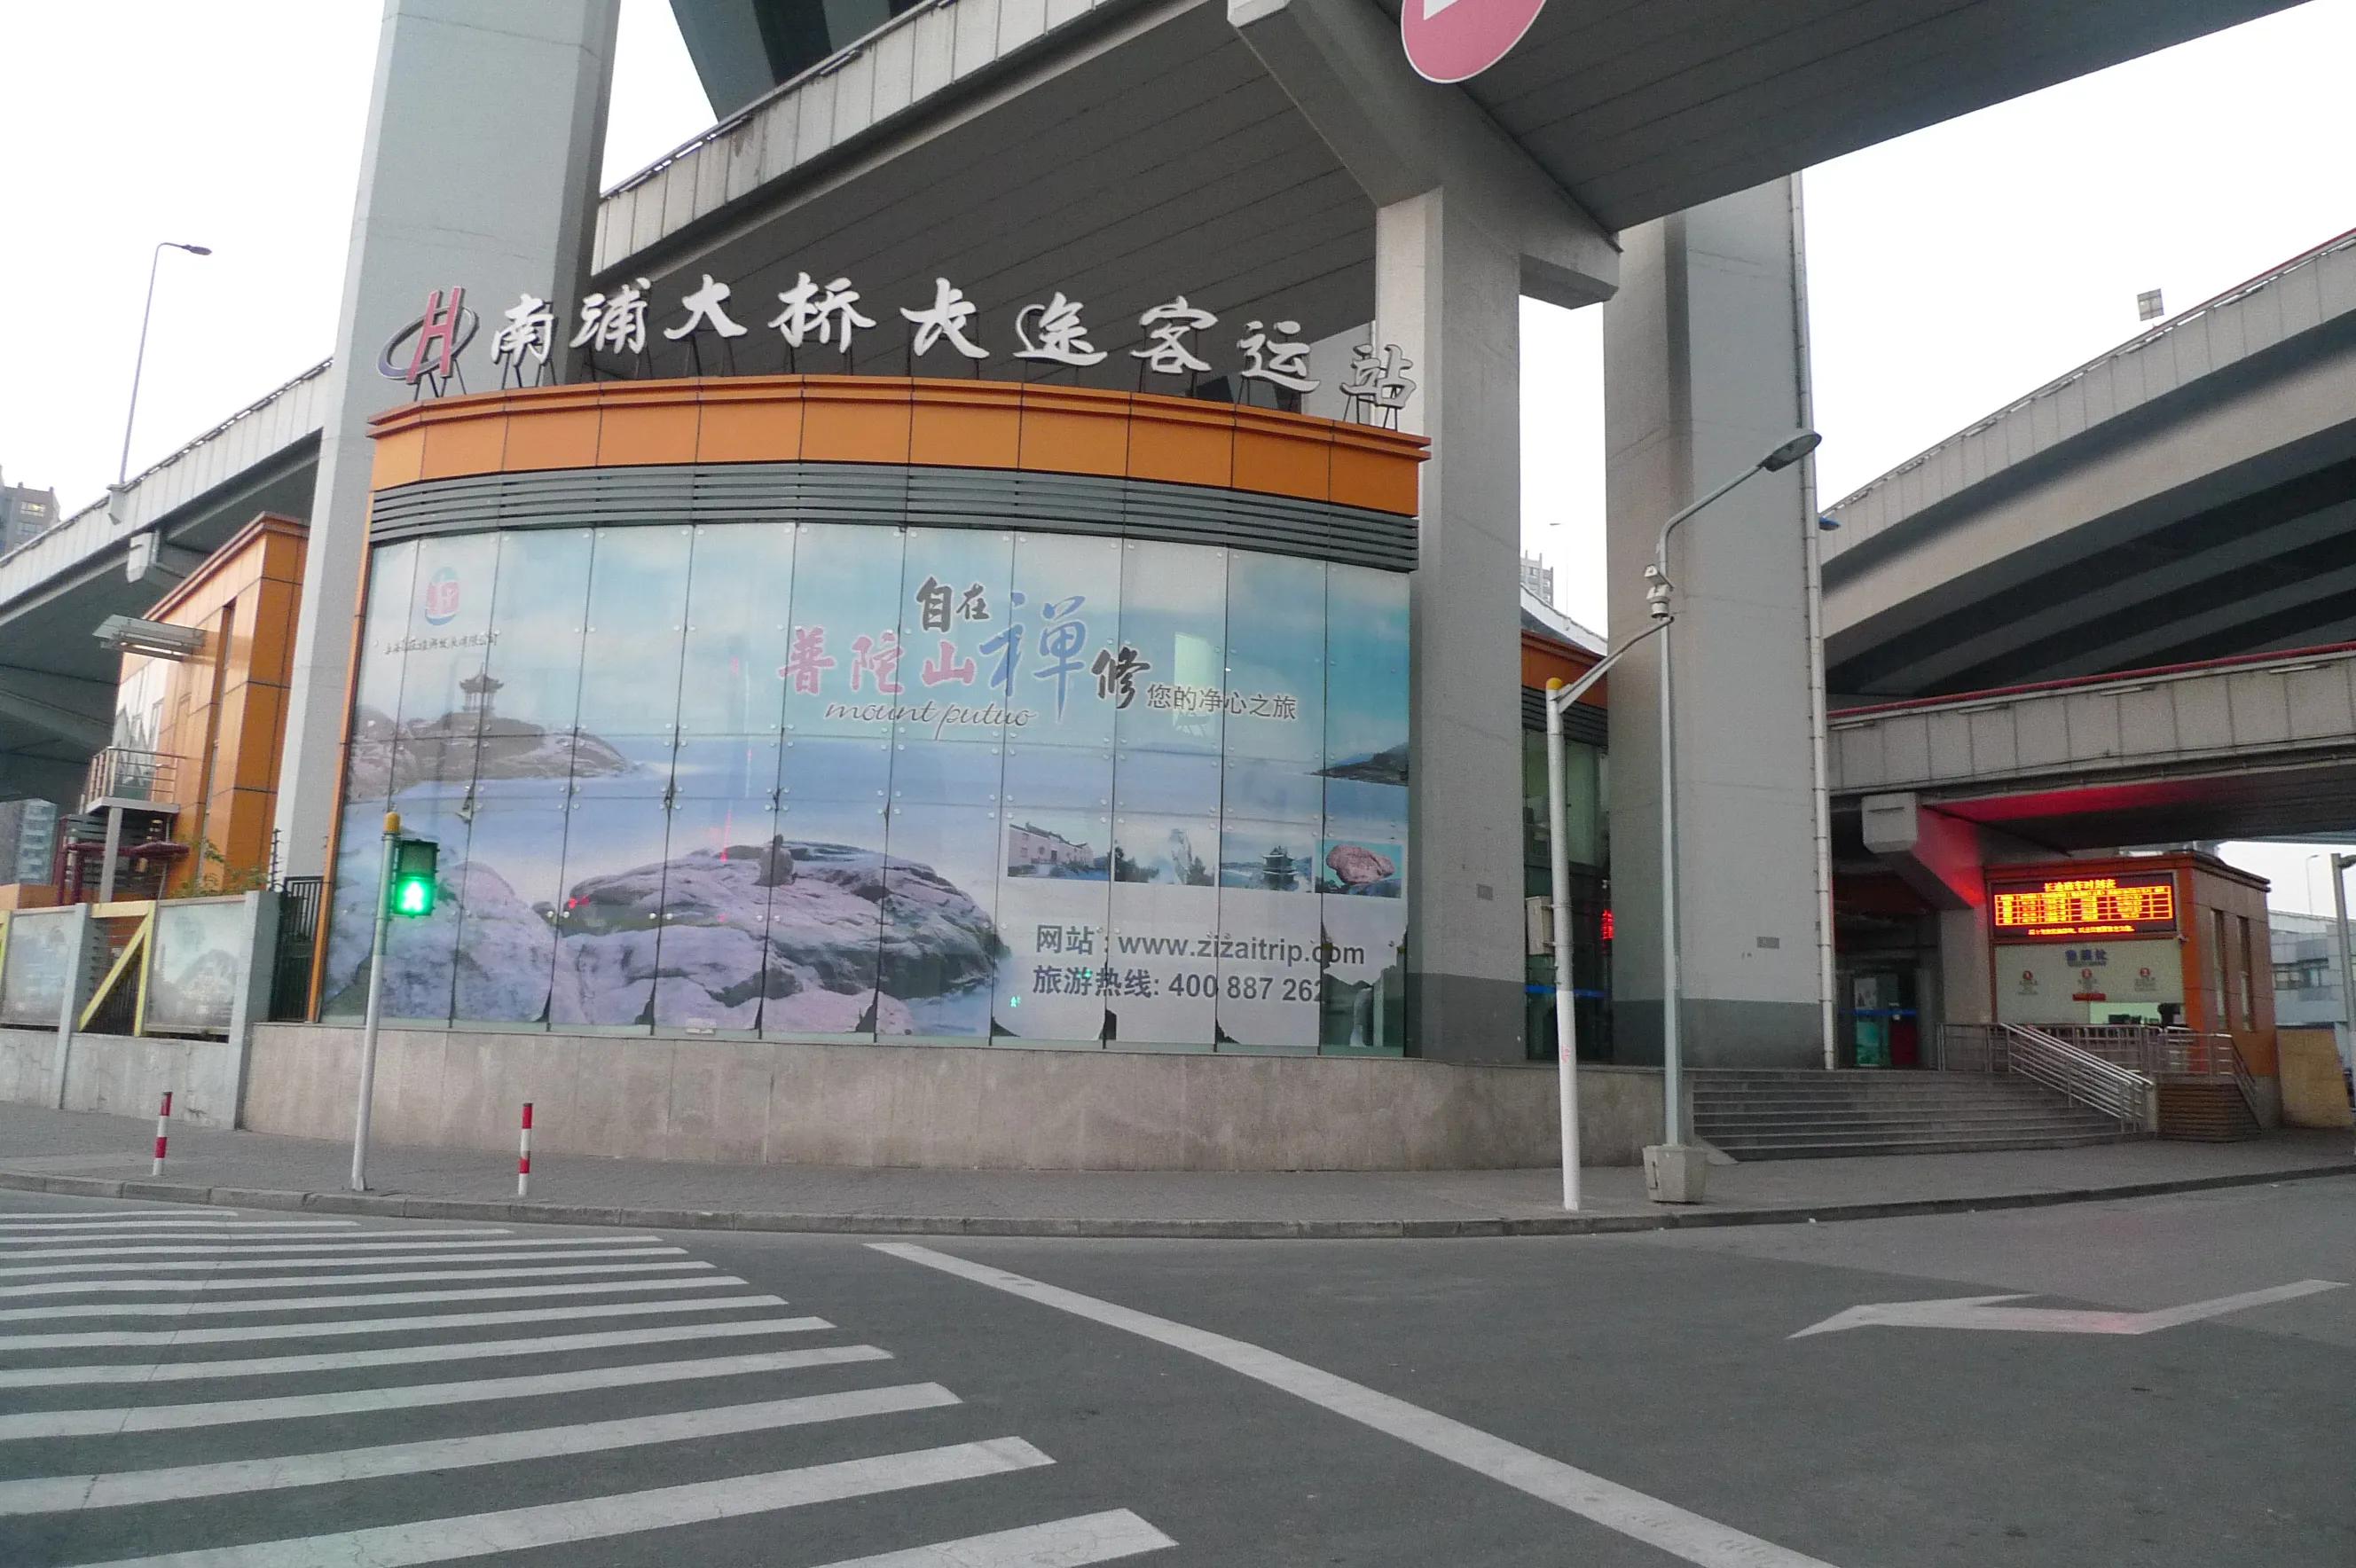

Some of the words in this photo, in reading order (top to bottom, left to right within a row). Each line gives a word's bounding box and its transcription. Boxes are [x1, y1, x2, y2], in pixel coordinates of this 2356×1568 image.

[491, 271, 1420, 408] 南浦大桥长途客运站
[915, 576, 991, 633] 自在
[824, 700, 937, 723] mount
[933, 701, 1034, 740] putuo
[1146, 682, 1298, 721] 您的净心之旅
[1168, 973, 1218, 998] 400
[1227, 976, 1273, 1000] 887
